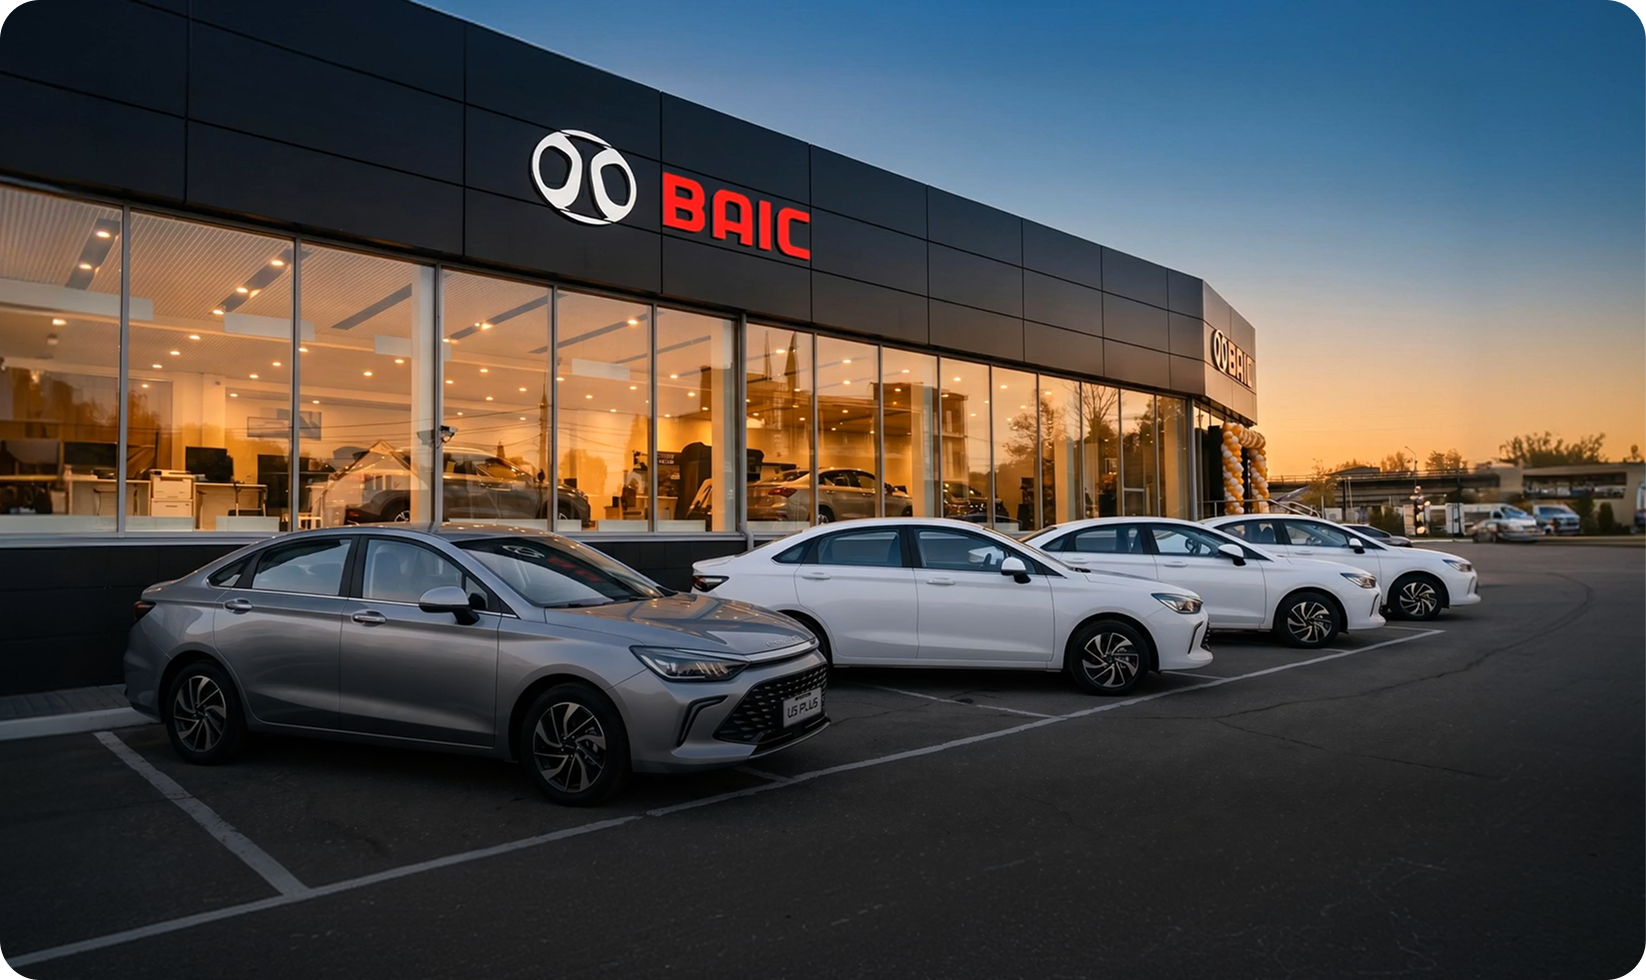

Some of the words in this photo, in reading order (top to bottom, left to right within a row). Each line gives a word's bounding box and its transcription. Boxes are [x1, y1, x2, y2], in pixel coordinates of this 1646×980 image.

[662, 171, 811, 261] BAIC
[1228, 340, 1253, 389] BAIC
[799, 697, 818, 714] PLUS
